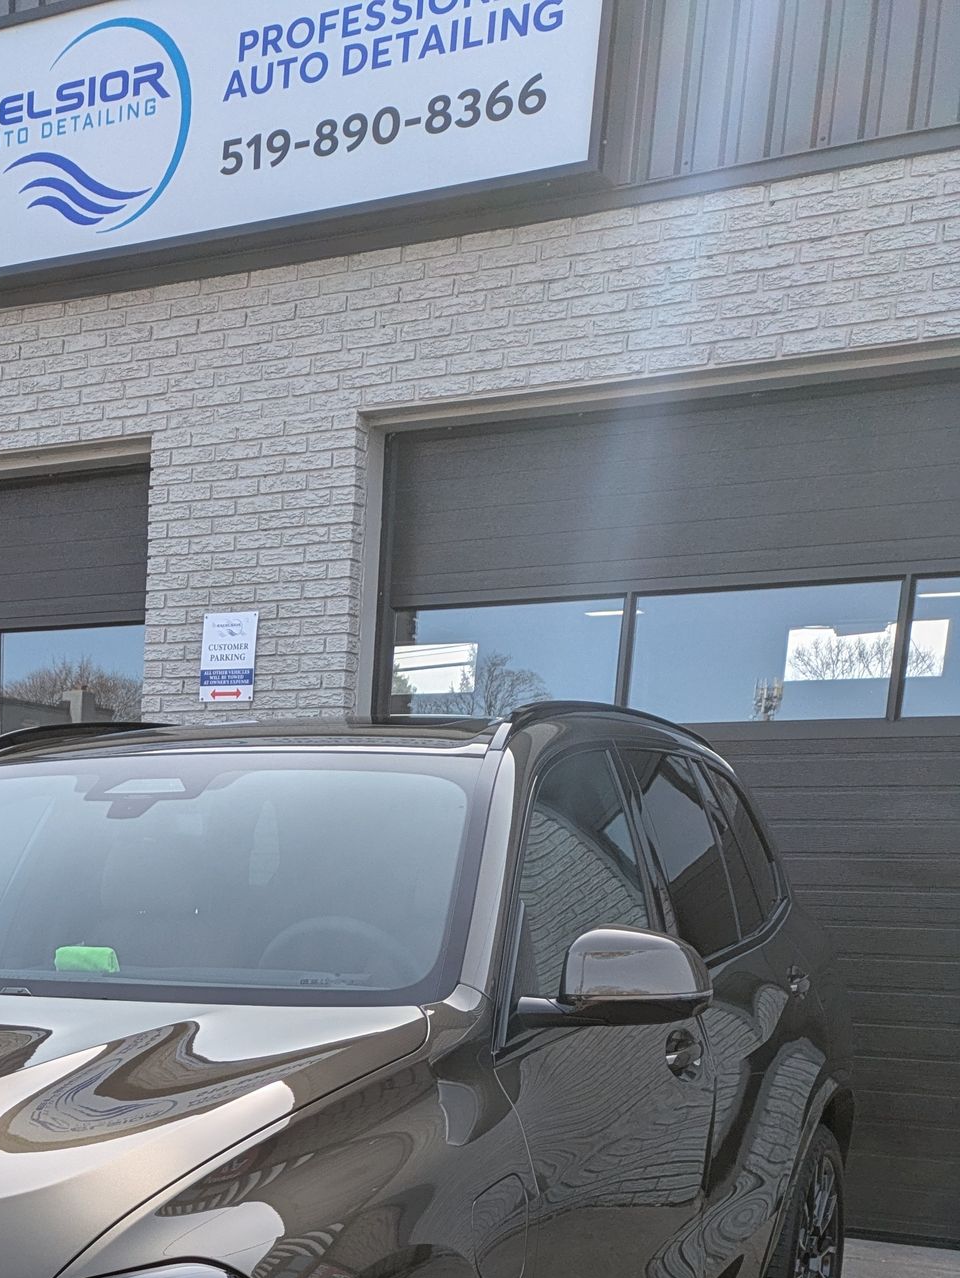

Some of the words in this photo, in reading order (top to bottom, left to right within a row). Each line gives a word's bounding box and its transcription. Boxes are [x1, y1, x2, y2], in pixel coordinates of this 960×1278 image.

[222, 51, 329, 102] AUTO
[342, 0, 565, 76] DETAILING
[40, 98, 157, 139] DETAILING
[219, 72, 547, 176] 519-890-8366
[208, 643, 249, 651] CUSTOMER
[210, 653, 246, 662] PARKING
